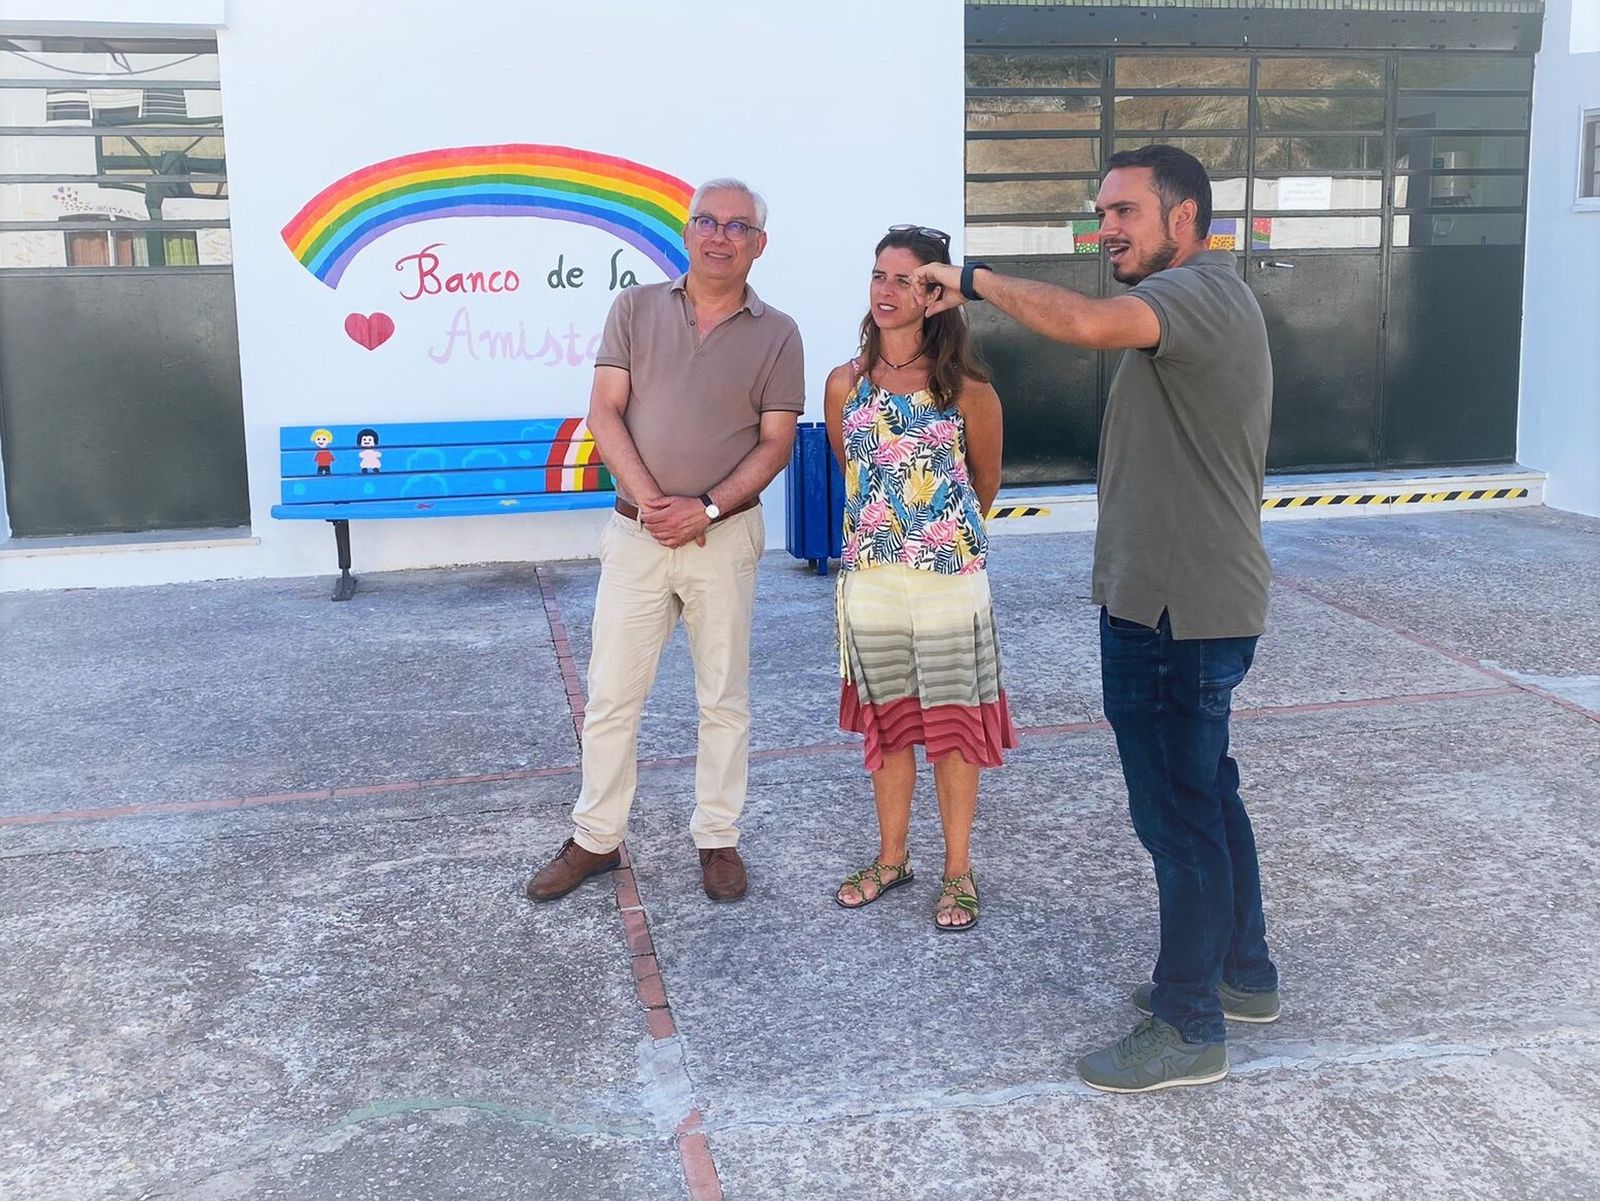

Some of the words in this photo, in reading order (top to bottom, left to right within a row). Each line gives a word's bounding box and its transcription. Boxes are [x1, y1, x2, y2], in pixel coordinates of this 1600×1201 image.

[395, 243, 520, 300] Banco
[547, 254, 584, 289] de
[609, 248, 639, 291] la
